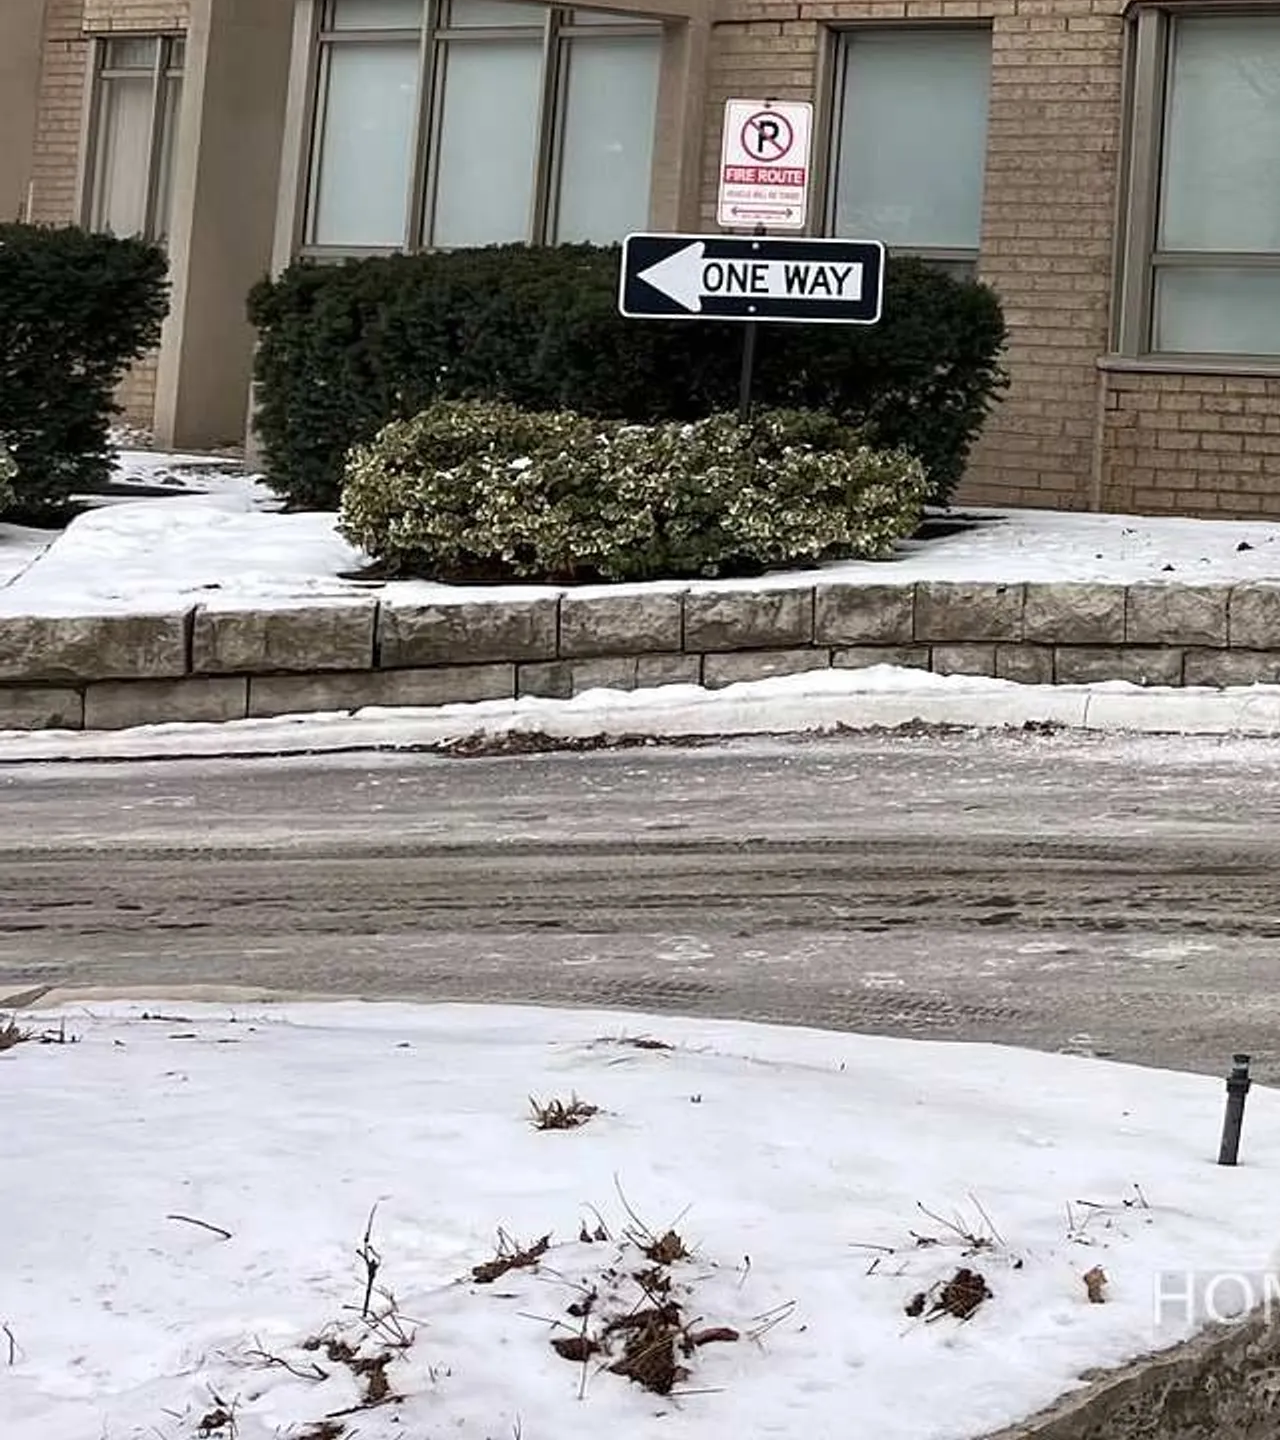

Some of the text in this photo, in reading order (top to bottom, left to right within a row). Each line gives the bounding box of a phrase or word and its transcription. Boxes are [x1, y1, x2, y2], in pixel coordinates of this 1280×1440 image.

[726, 168, 802, 183] FIRE ROUTE
[702, 263, 851, 295] ONE WAY
